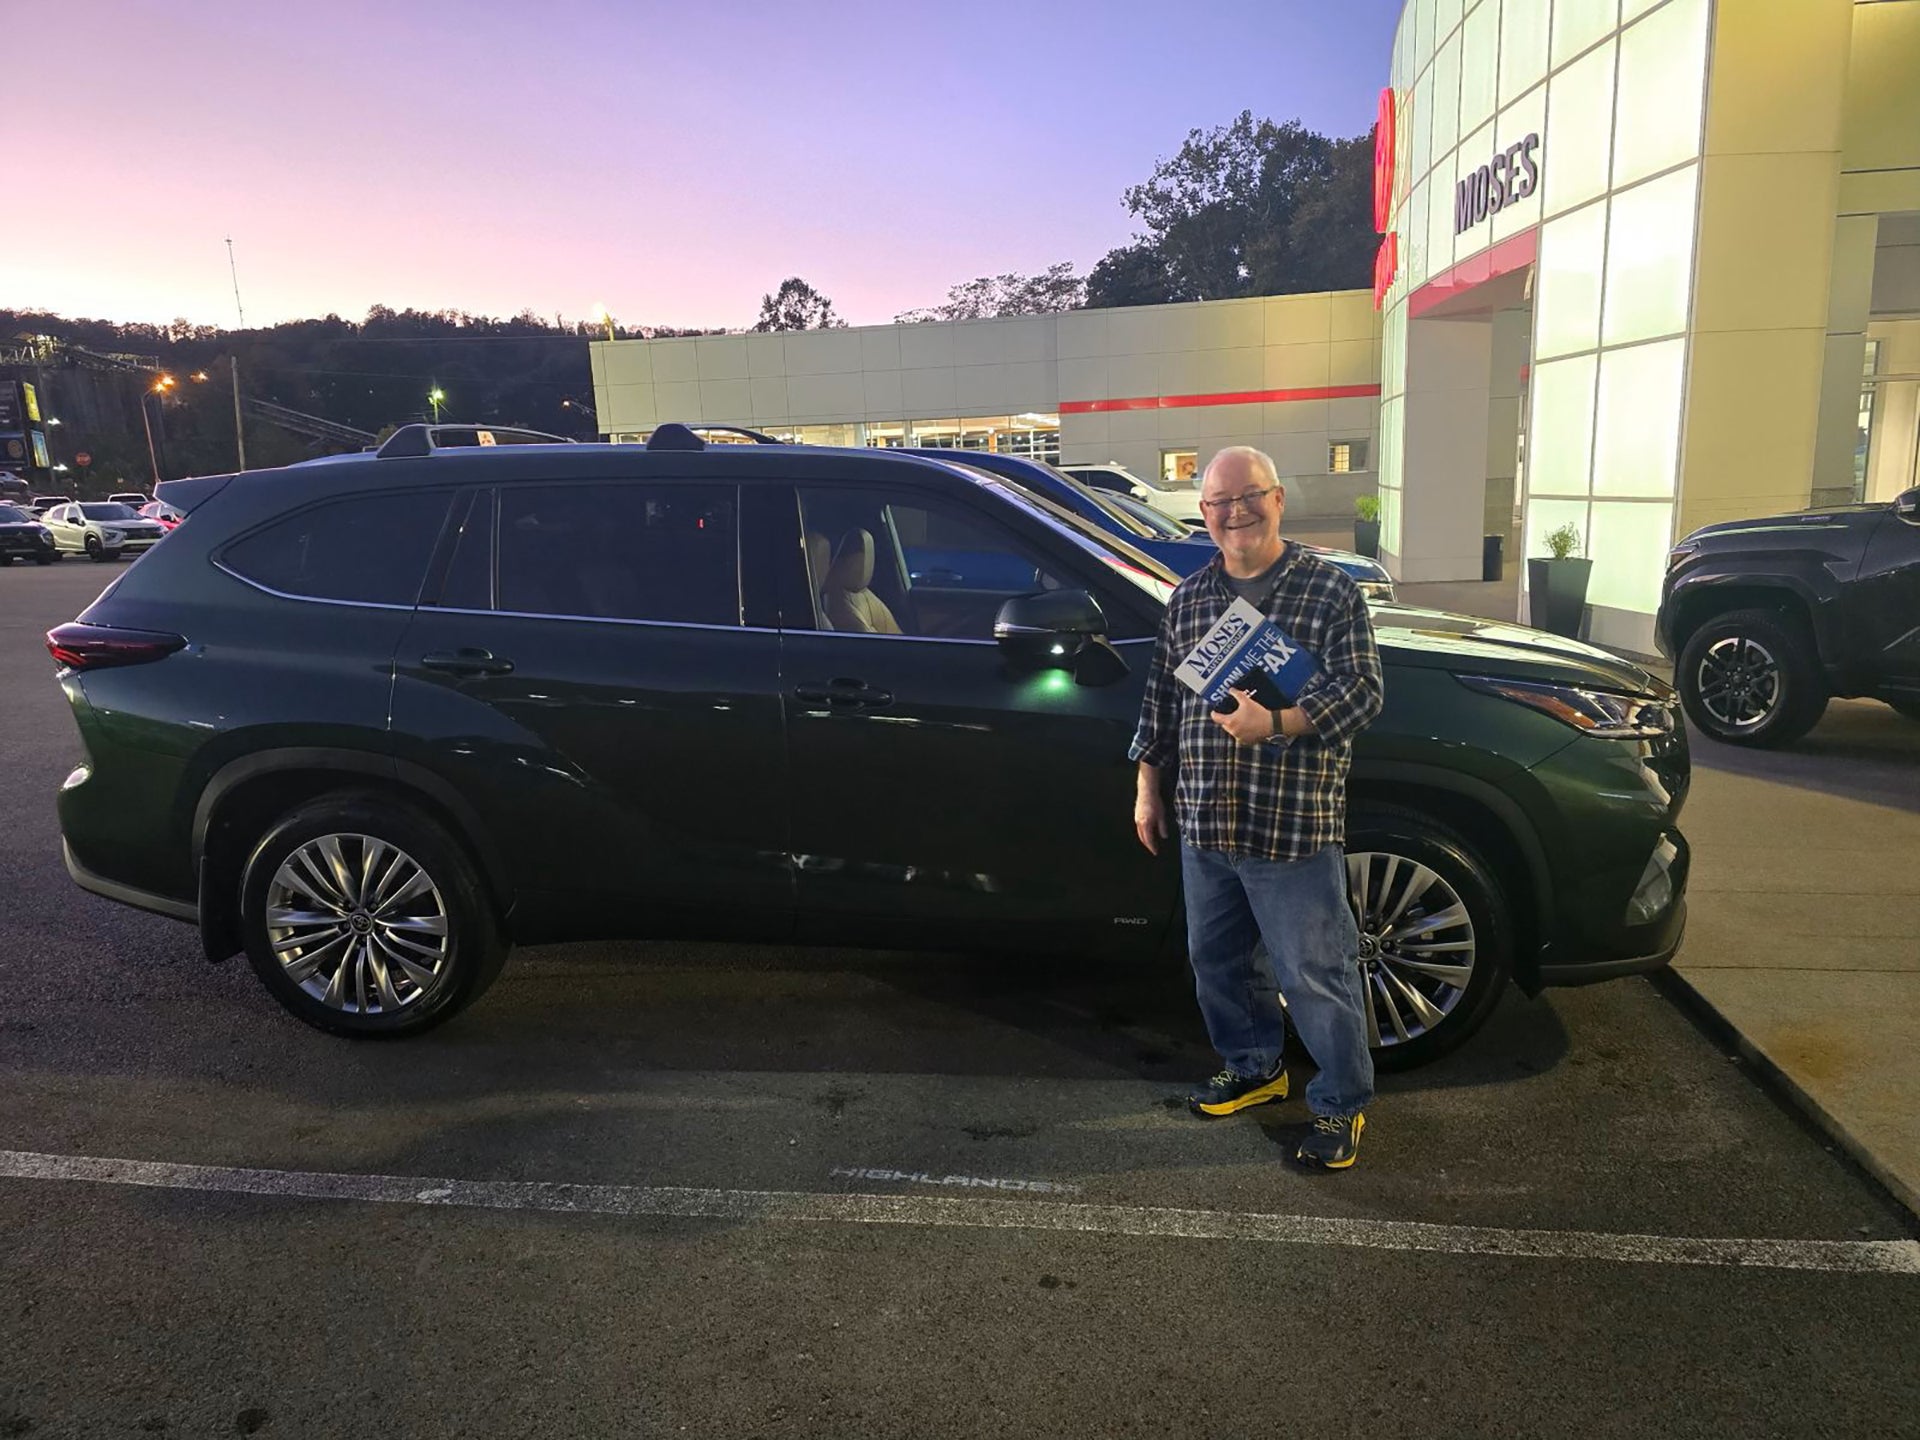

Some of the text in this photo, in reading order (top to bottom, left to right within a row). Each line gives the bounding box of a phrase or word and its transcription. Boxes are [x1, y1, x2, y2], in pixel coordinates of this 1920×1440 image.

[1454, 133, 1539, 235] MOSES
[1186, 613, 1245, 676] MOSES
[1207, 630, 1246, 675] AUTO GROUP
[1210, 627, 1281, 704] SHOW ME THE
